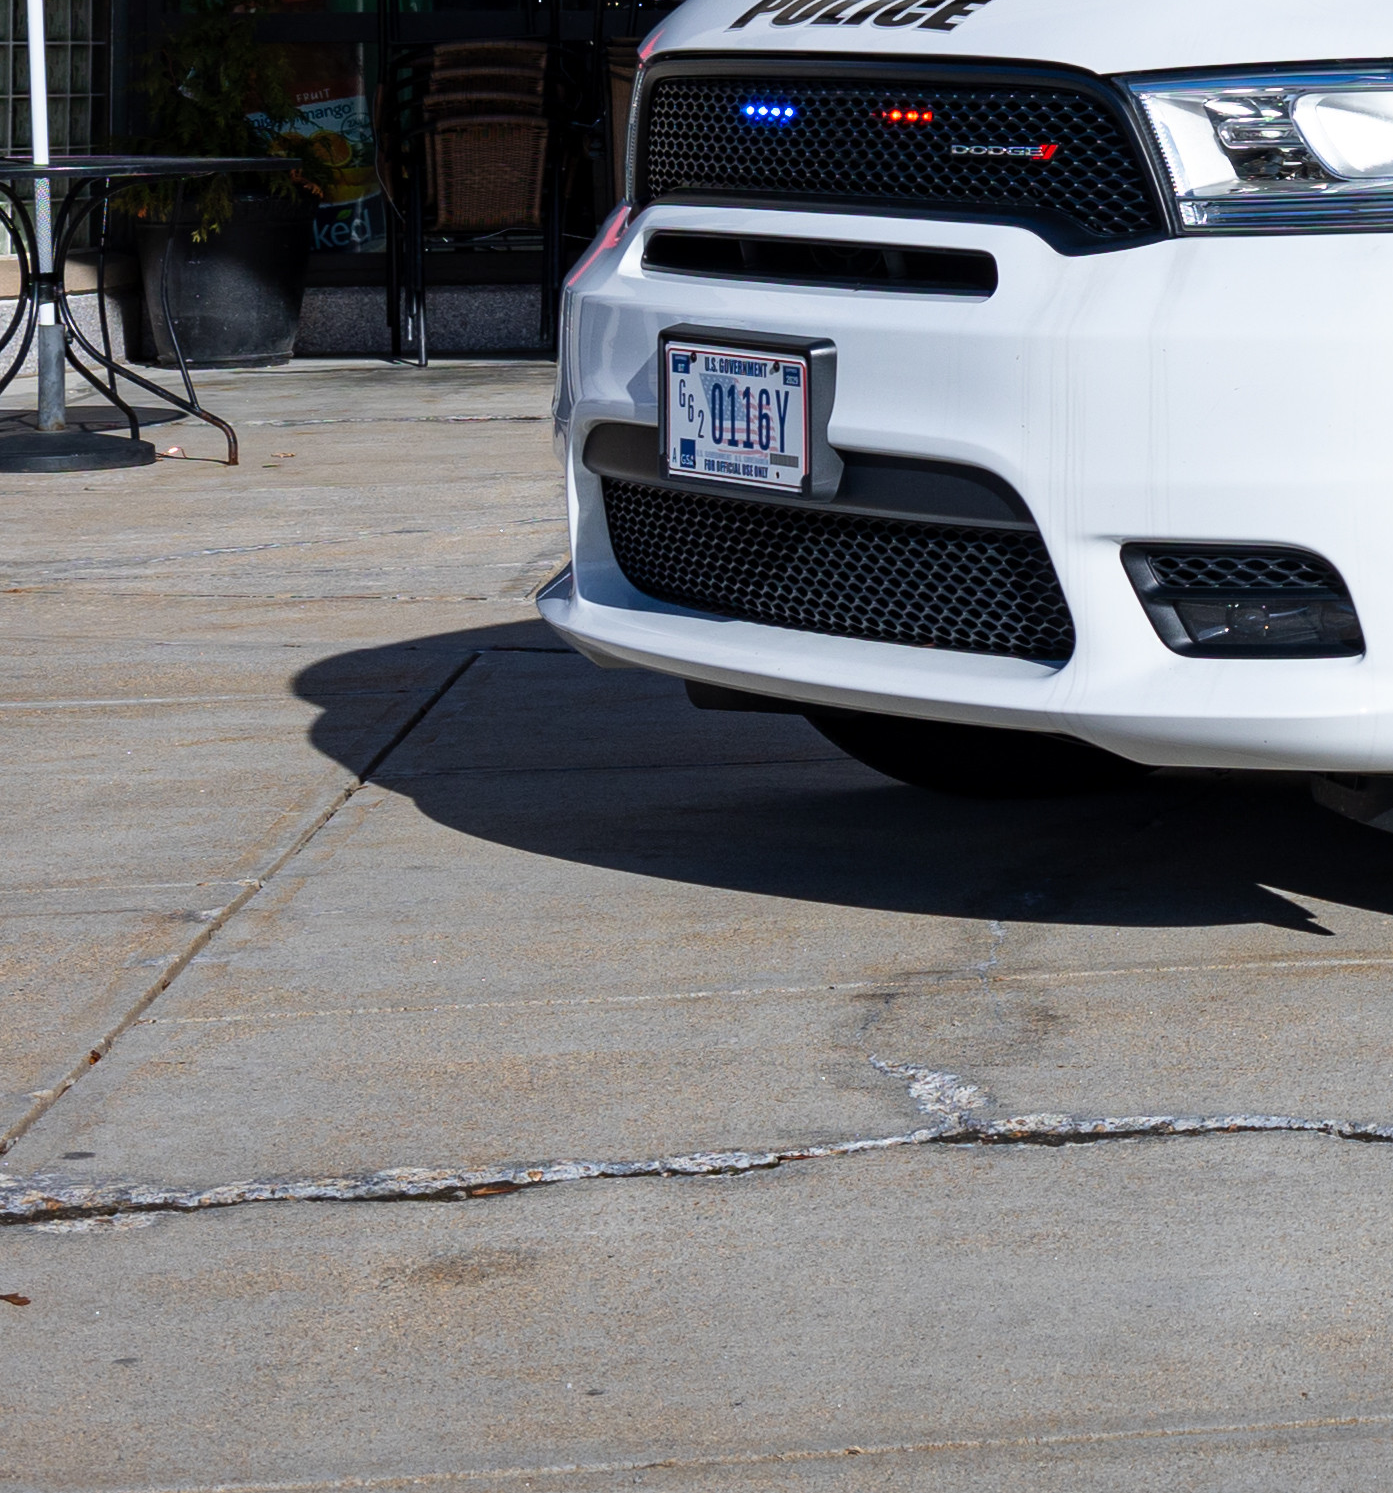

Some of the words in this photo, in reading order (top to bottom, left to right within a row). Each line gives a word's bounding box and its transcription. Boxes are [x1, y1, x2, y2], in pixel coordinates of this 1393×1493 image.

[295, 88, 331, 103] FRUIT
[951, 145, 1044, 156] DODGE
[704, 356, 718, 373] U.S.
[719, 358, 768, 378] GOVERNMENT
[711, 383, 789, 453] 0116Y
[680, 454, 696, 466] GSA
[704, 458, 715, 472] FOR
[716, 460, 741, 475] OFFICIAL
[742, 464, 753, 477] USE
[754, 466, 768, 479] ONLY
